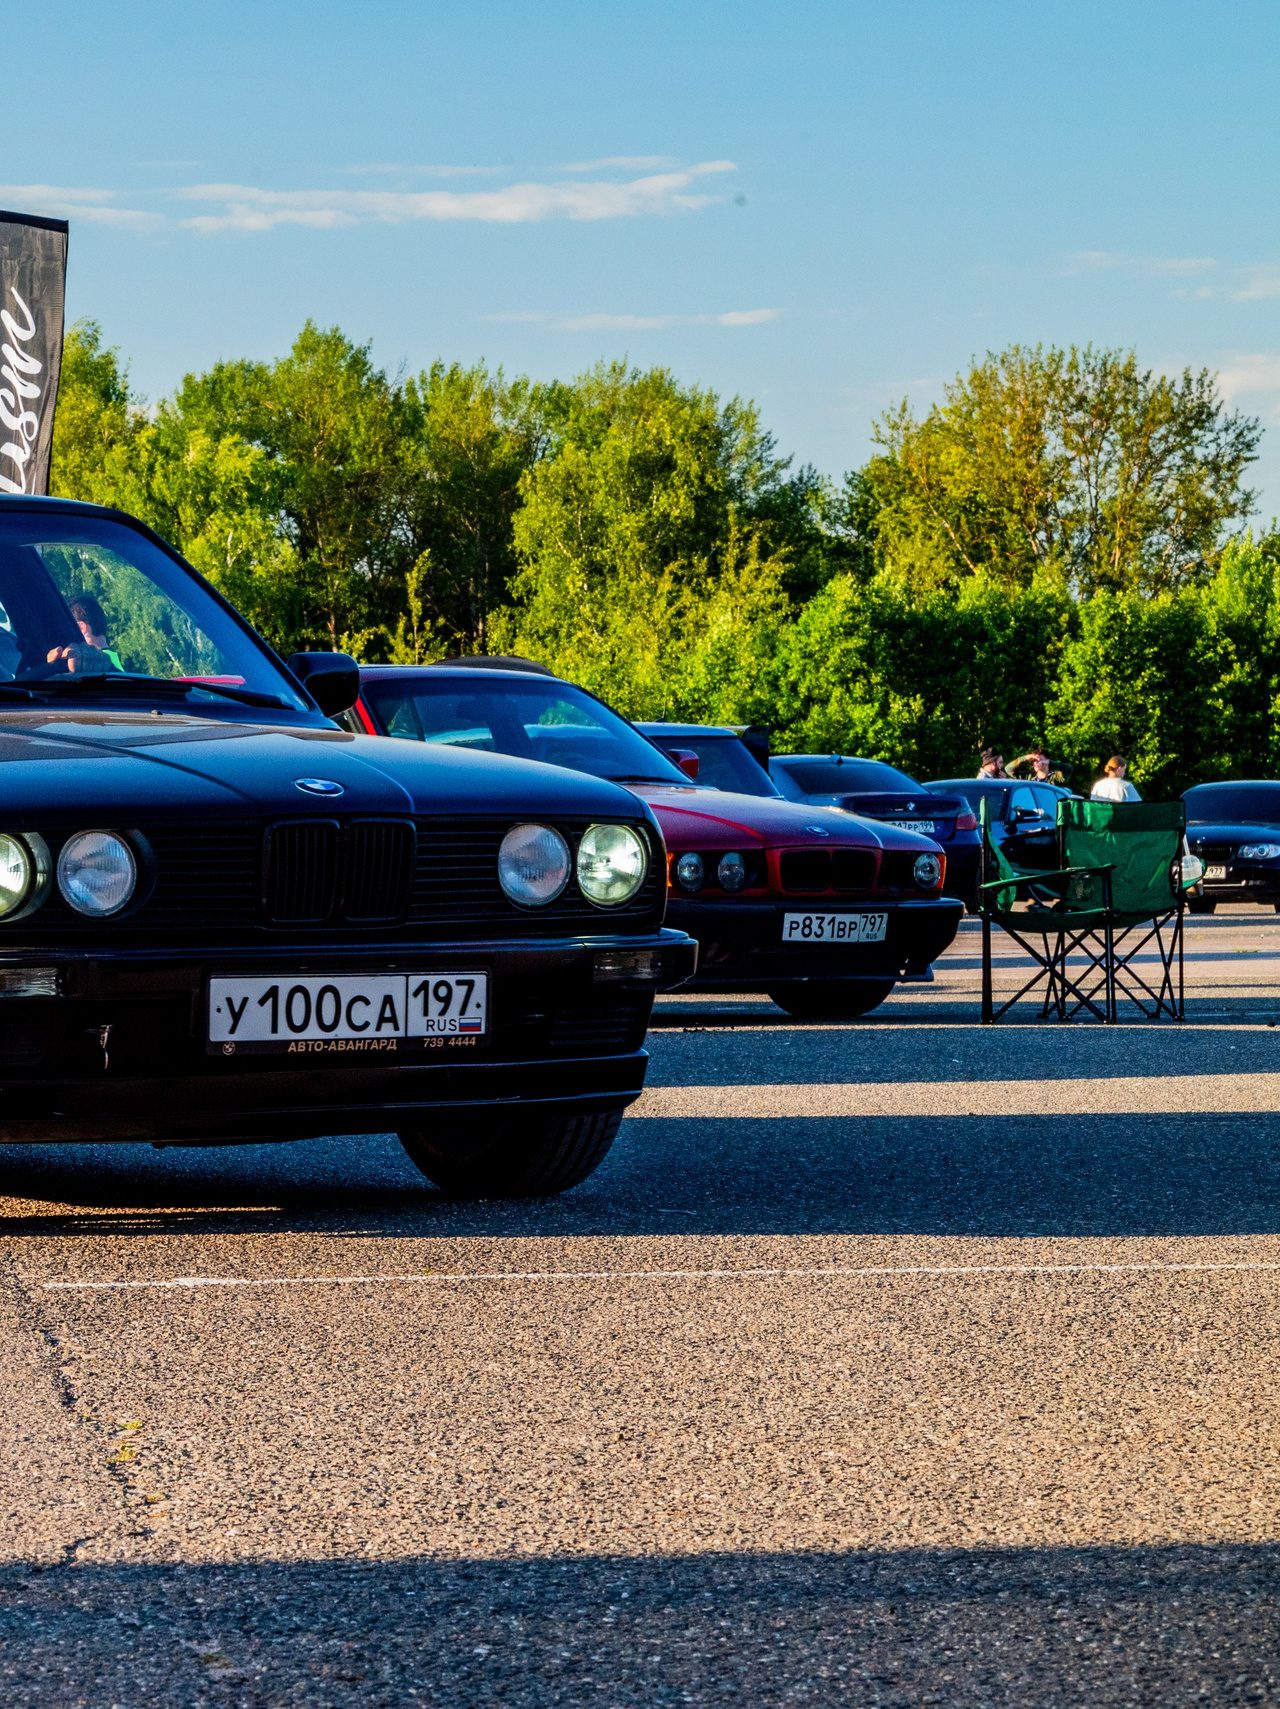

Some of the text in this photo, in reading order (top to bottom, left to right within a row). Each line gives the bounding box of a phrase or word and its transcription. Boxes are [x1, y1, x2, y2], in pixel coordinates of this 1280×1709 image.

[788, 914, 884, 938] Р831ВР 797
[224, 979, 476, 1035] У100СА 197
[425, 1018, 457, 1032] RUS
[287, 1036, 477, 1053] АВТО-АВАНГАРД 739 4444
